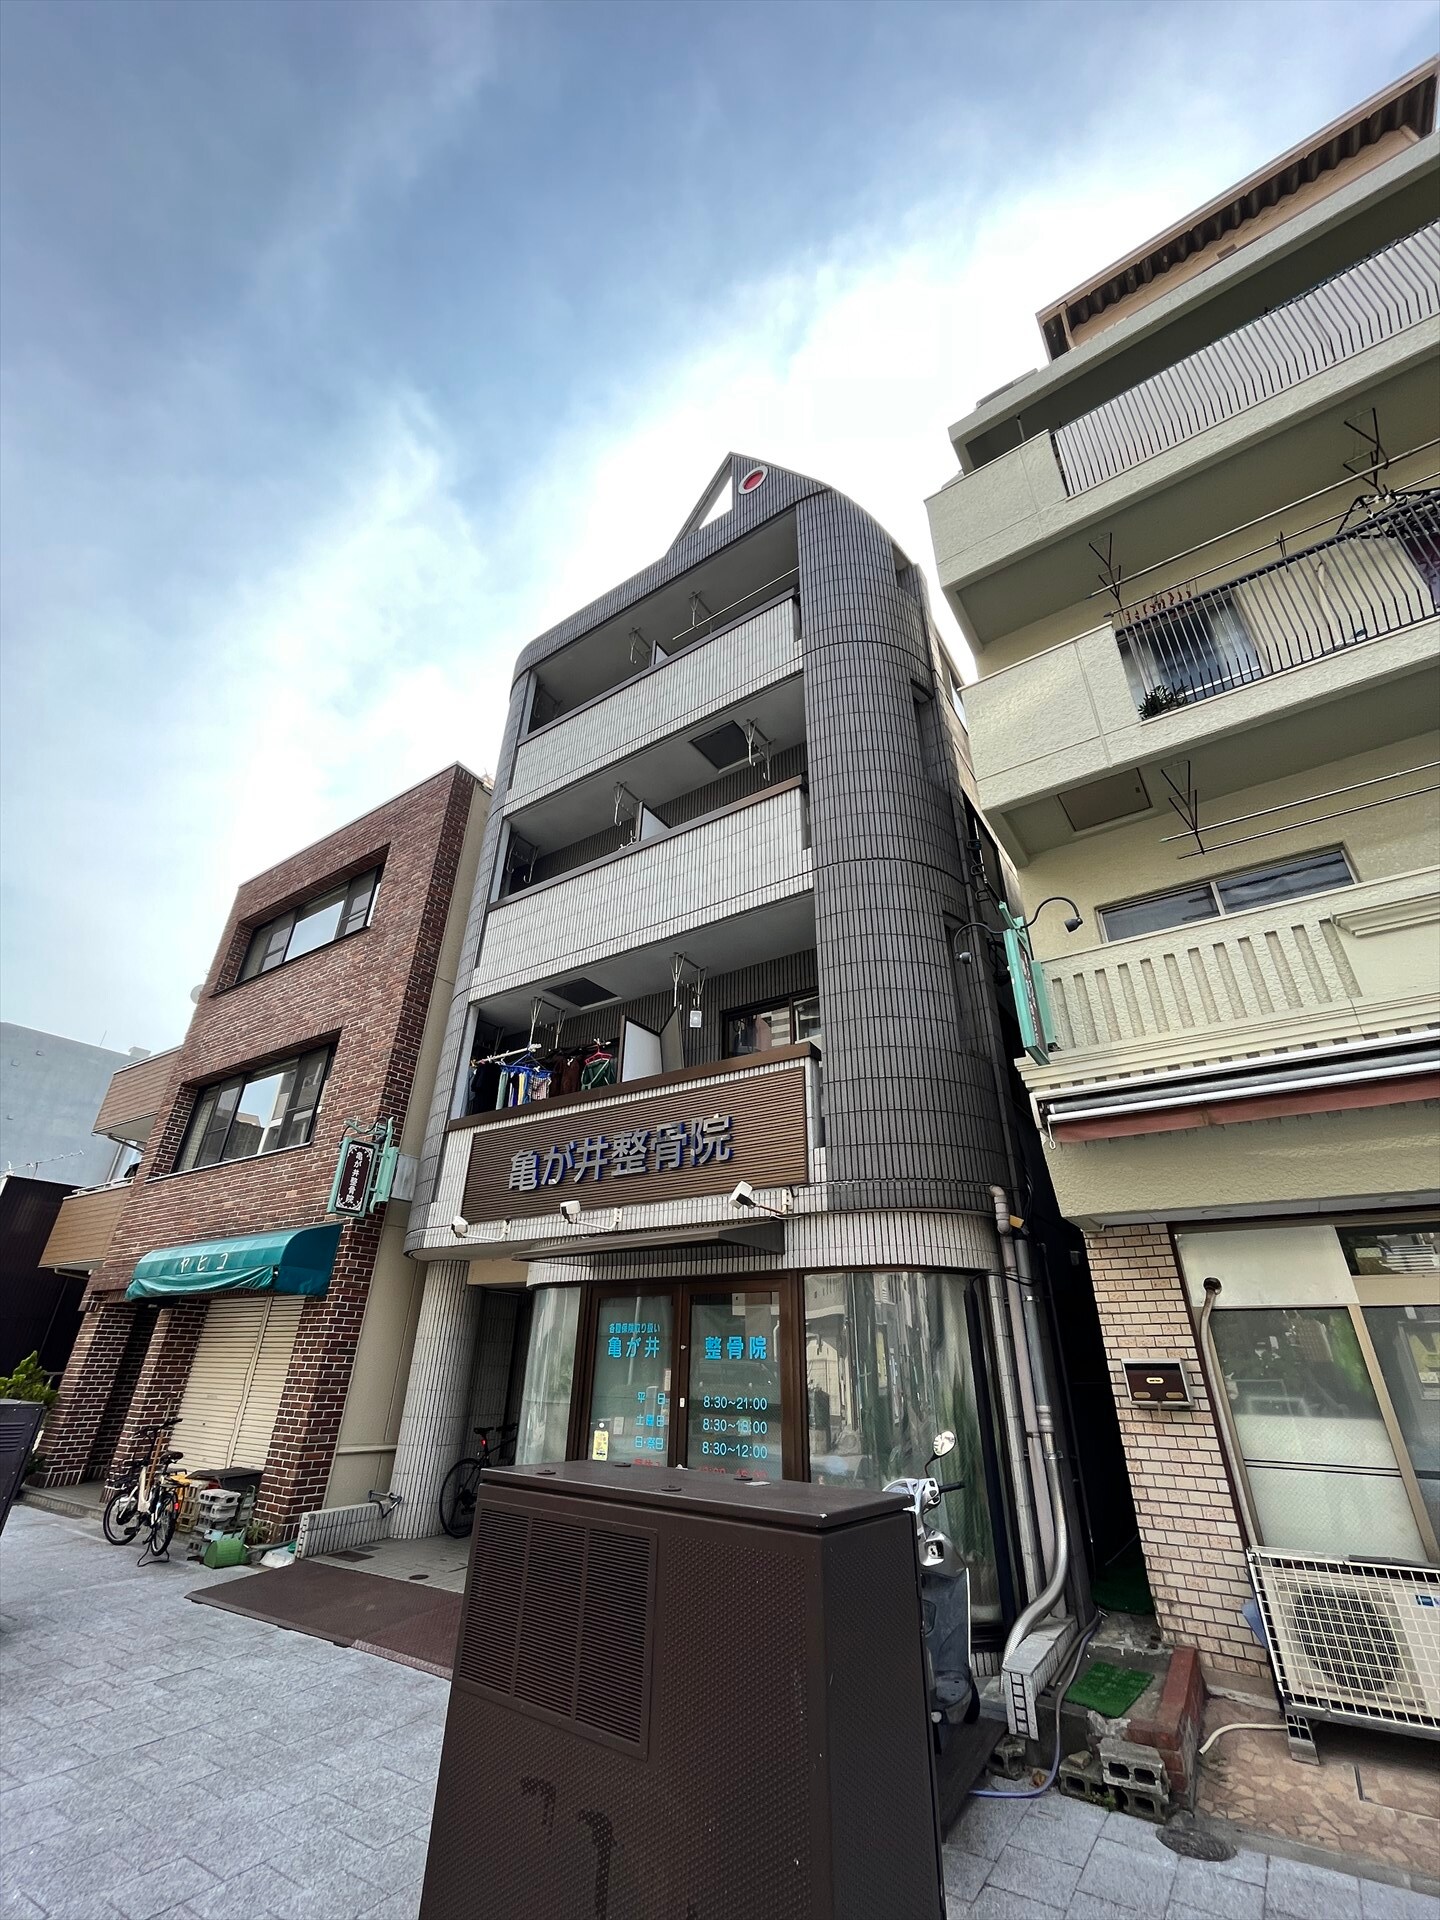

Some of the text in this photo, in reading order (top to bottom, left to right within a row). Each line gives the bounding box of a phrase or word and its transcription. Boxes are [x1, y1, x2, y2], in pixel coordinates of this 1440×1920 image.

[508, 1113, 733, 1192] 亀が井整骨院
[180, 1252, 229, 1274] ヤヒコ
[608, 1335, 767, 1360] 亀が井 整骨院
